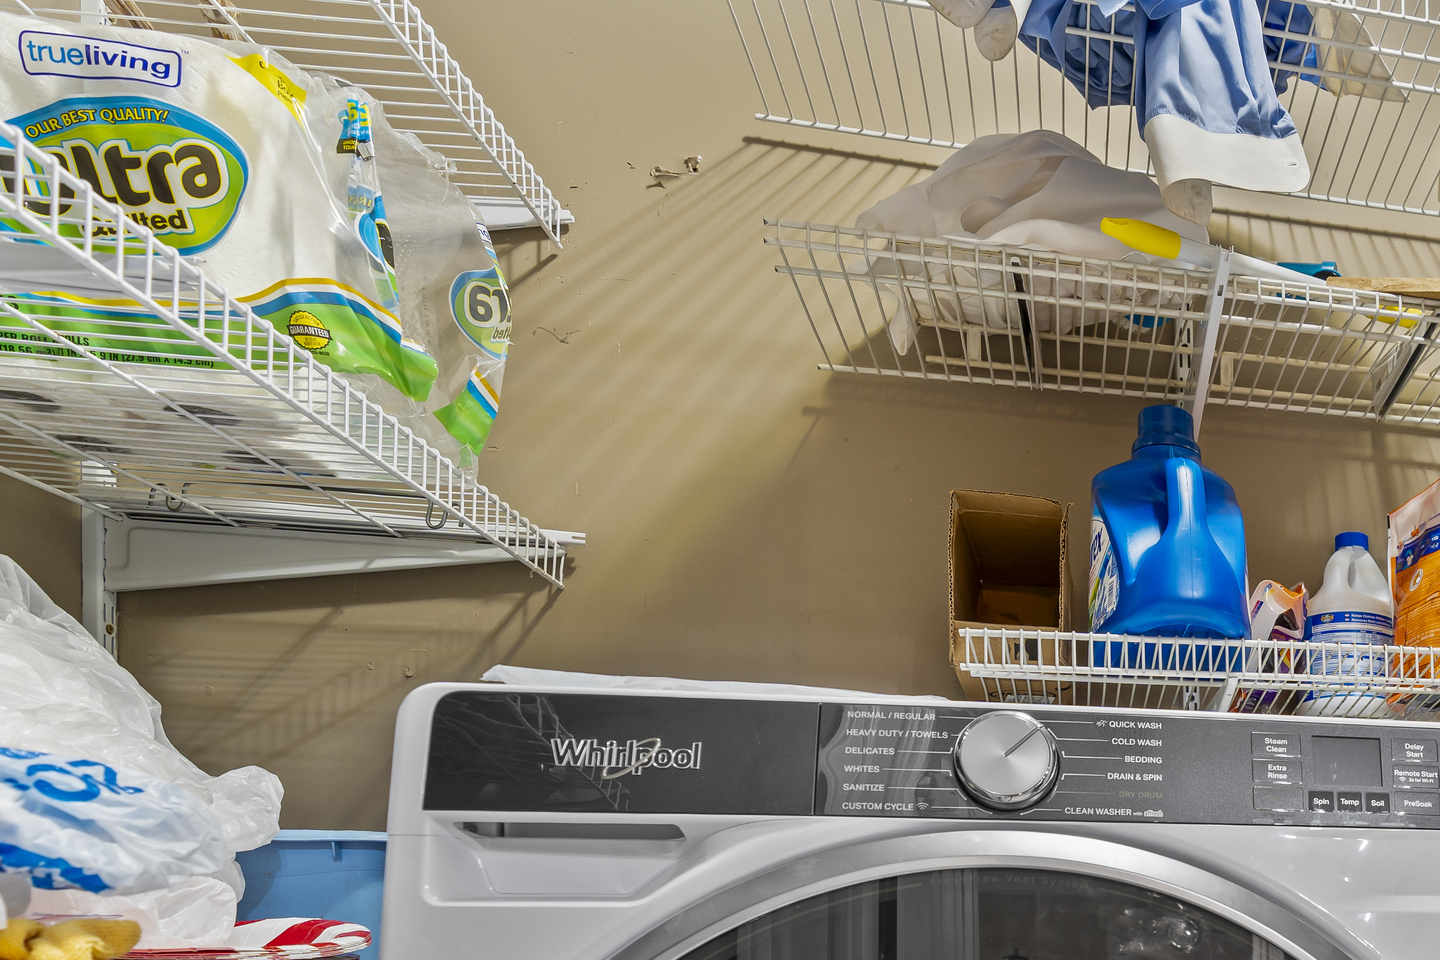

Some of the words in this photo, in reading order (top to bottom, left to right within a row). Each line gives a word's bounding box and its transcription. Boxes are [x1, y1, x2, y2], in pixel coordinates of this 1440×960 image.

[27, 40, 170, 79] trueliving
[25, 119, 61, 138] OUR
[62, 109, 96, 127] BEST
[100, 107, 169, 123] QUALITY!
[81, 209, 188, 237] Qulted
[289, 326, 329, 338] GUARANTEED
[847, 711, 886, 719] NORMAL
[894, 712, 936, 720] REGULAR
[1109, 720, 1136, 729] QUICK
[1137, 721, 1162, 730] WASH
[846, 729, 877, 737] HEAVY
[878, 729, 903, 737] DUTY
[905, 730, 909, 738] /
[911, 730, 948, 739] TOWELS
[1112, 738, 1135, 746] COLD
[1137, 738, 1162, 747] WASH
[1264, 737, 1288, 745] Steam
[845, 747, 895, 756] DELICATES
[1266, 745, 1287, 753] Clean
[1404, 743, 1424, 751] Delay
[551, 738, 702, 776] Whirlpool
[1124, 755, 1162, 764] BEDDING
[844, 765, 880, 773] WHITES
[1394, 769, 1421, 777] Remote
[1107, 772, 1134, 780] DRAIN
[1135, 773, 1141, 781] &
[1142, 773, 1162, 782] SPIN
[1267, 772, 1288, 780] Rinse
[843, 783, 885, 792] SANITIZE
[1119, 790, 1136, 798] DRY
[1138, 791, 1162, 799] DRUM
[1313, 797, 1330, 805] Spin
[1340, 798, 1360, 807] Temp
[1371, 799, 1385, 807] Soil
[1404, 799, 1433, 808] PreSoak
[842, 802, 882, 810] CUSTOM
[884, 803, 914, 811] CYCLE
[1064, 806, 1094, 815] CLEAN
[1096, 807, 1132, 816] WASHER
